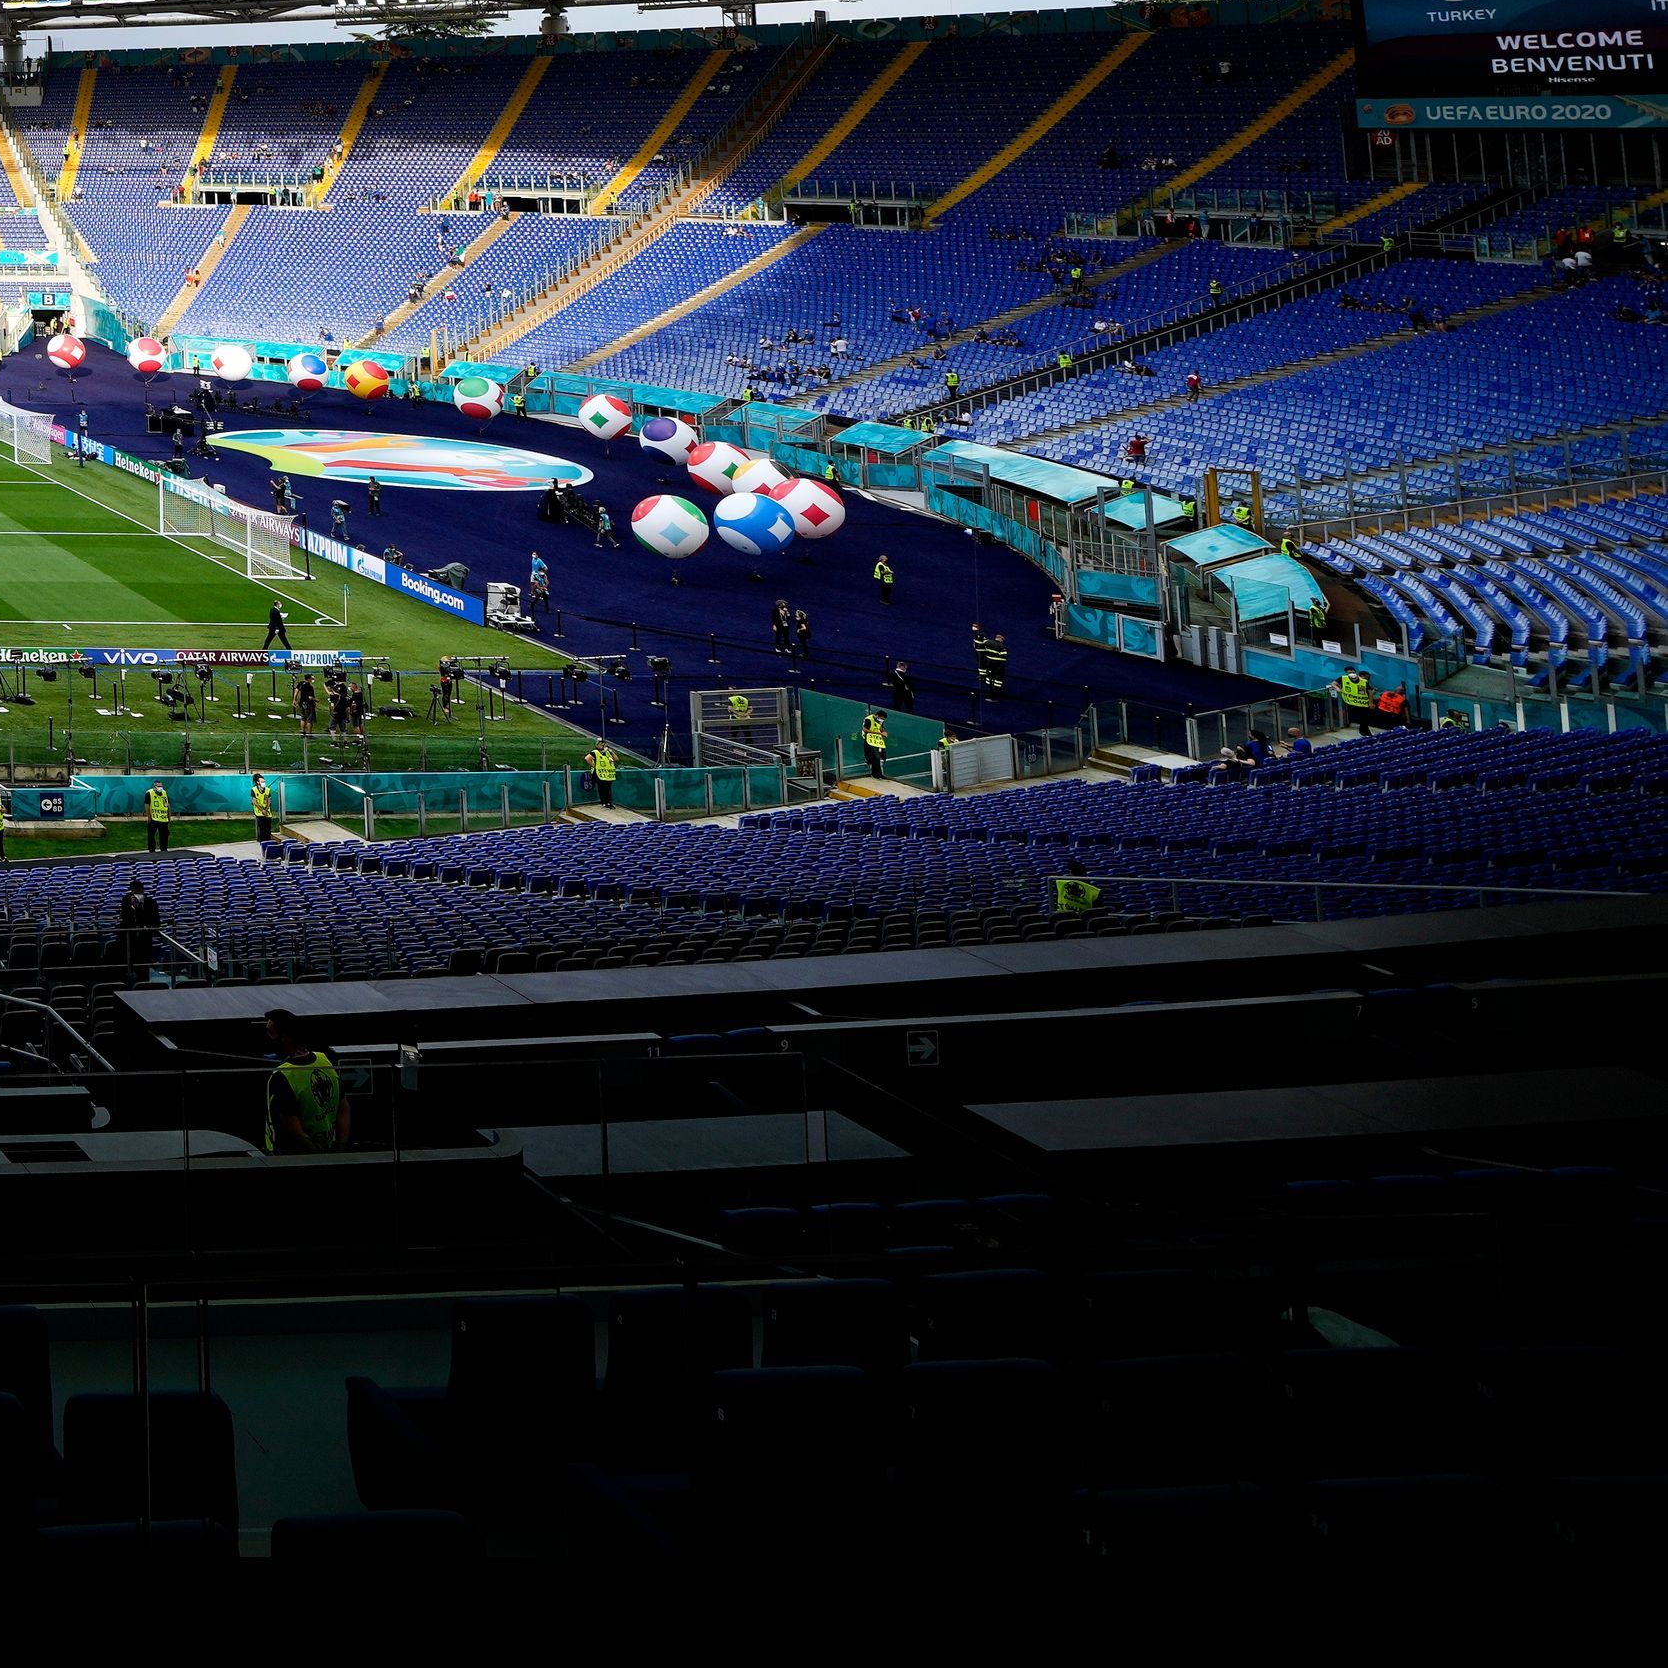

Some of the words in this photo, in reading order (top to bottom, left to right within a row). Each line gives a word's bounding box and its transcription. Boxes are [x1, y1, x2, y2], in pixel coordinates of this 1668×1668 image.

[1426, 8, 1497, 22] TURKEY
[1496, 29, 1644, 51] WELCOME
[1492, 53, 1654, 74] BENVENUTI
[1548, 76, 1595, 84] Hisense
[1426, 105, 1483, 120] UEFA
[1485, 105, 1547, 120] EURO
[1551, 104, 1612, 120] 2020
[44, 294, 54, 304] B
[114, 452, 156, 482] Heineken
[402, 572, 464, 611] Booking.com
[104, 649, 158, 664] vivo
[176, 652, 216, 662] QATAR
[219, 652, 269, 663] AIRWAYS
[648, 1046, 660, 1058] 11
[780, 1039, 788, 1052] 9
